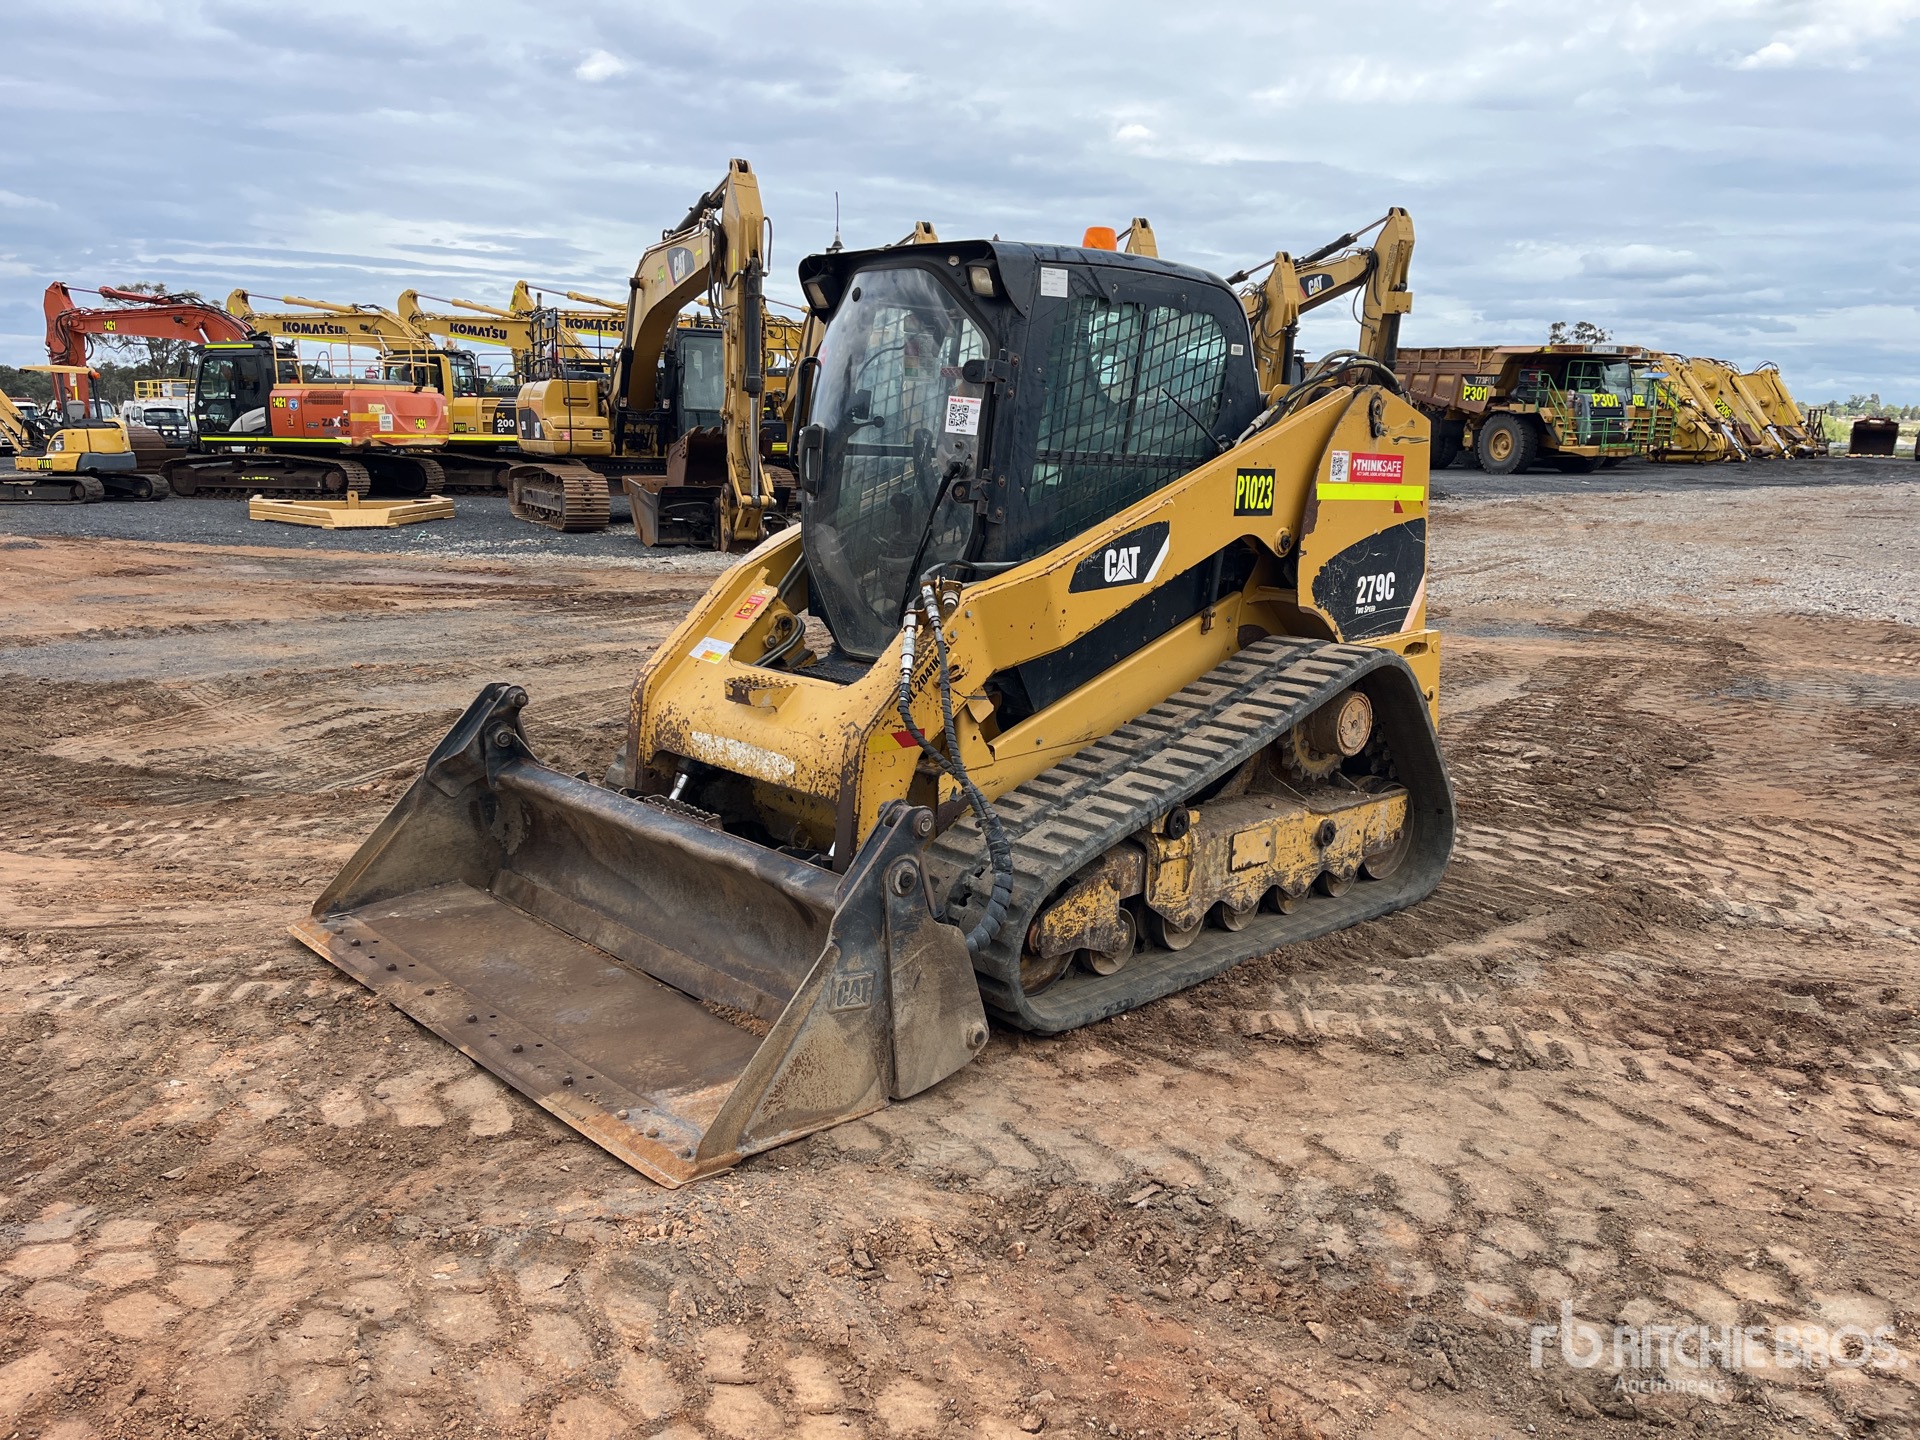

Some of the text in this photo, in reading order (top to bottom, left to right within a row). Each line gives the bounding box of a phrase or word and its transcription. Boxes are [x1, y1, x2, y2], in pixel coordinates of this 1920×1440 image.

[673, 249, 686, 281] CAT
[1308, 275, 1323, 295] CAT
[282, 321, 348, 334] KOMATSU
[449, 322, 508, 340] KOMATSU
[565, 317, 625, 332] KOMATSU
[1463, 385, 1488, 401] P301
[1592, 393, 1619, 407] P301
[1714, 397, 1732, 418] P206
[497, 419, 515, 428] 200
[1356, 458, 1402, 473] THINKSAFE
[1235, 475, 1273, 509] P1023
[1104, 546, 1141, 583] CAT
[1355, 571, 1396, 604] 279C
[836, 979, 870, 1007] CAT
